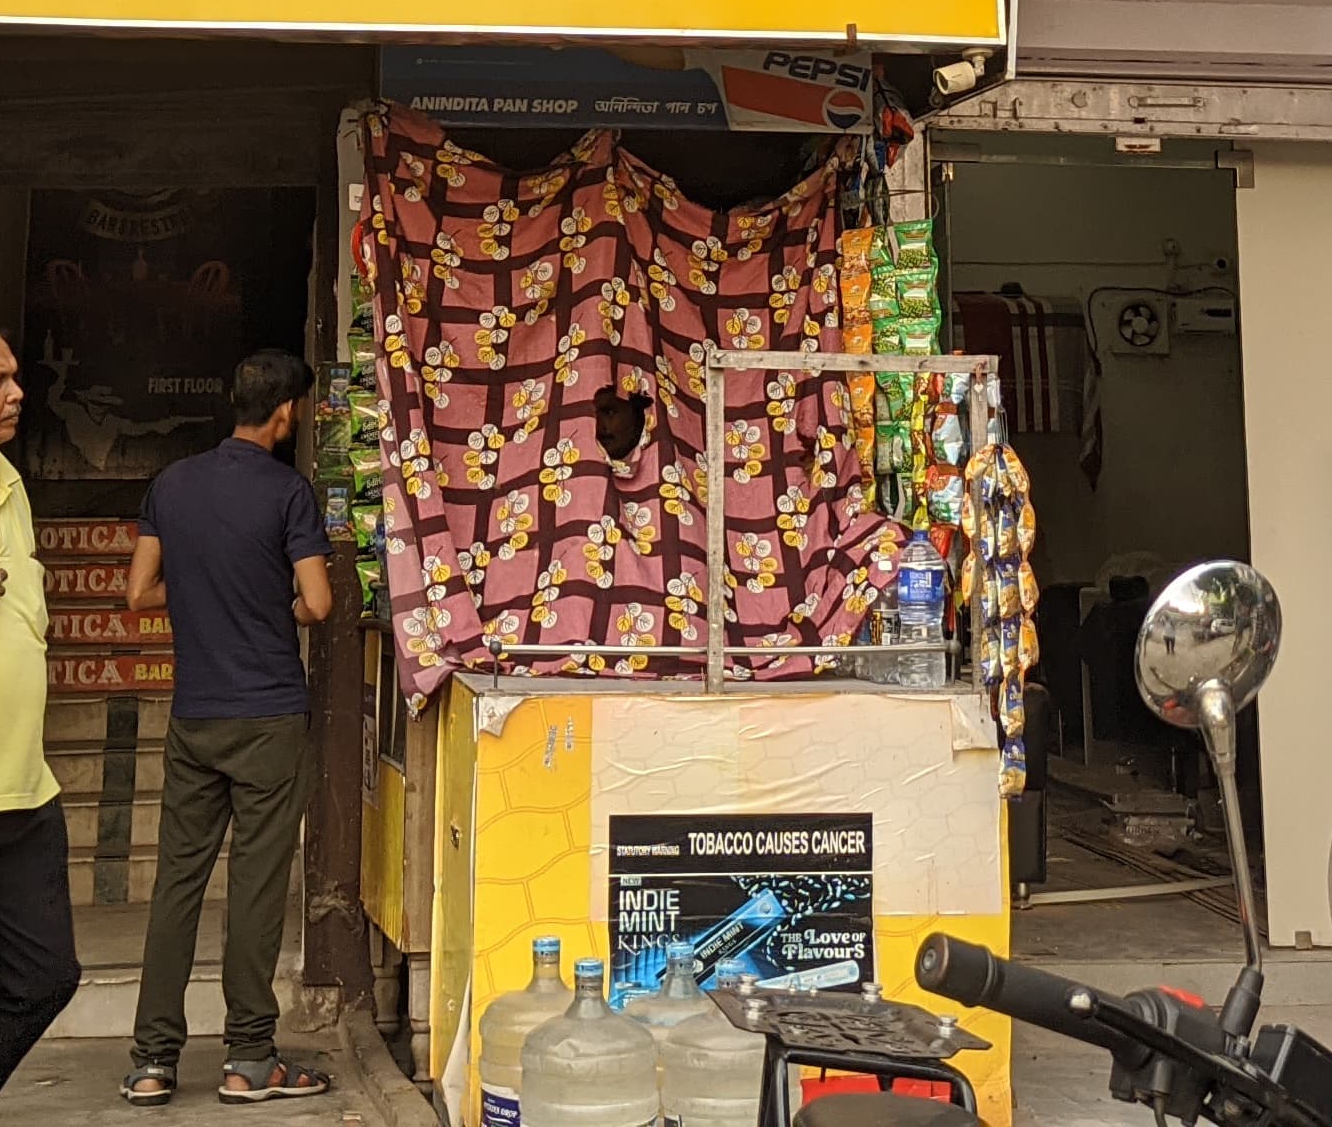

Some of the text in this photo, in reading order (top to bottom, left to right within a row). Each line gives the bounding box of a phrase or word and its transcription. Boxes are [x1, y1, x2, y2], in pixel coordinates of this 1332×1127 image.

[762, 50, 872, 93] PEPSI
[409, 95, 578, 114] ANINDITA PAN SHOP
[148, 376, 224, 394] FIRST FLOOR
[36, 525, 135, 550] OTICA
[687, 831, 753, 856] TOBACCO
[755, 831, 809, 855] CAUSES
[811, 830, 866, 854] CANCER
[619, 890, 680, 910] INDIE
[618, 911, 680, 932] MINT
[699, 920, 745, 960] INDIE MINT
[780, 928, 867, 945] THE Love OF
